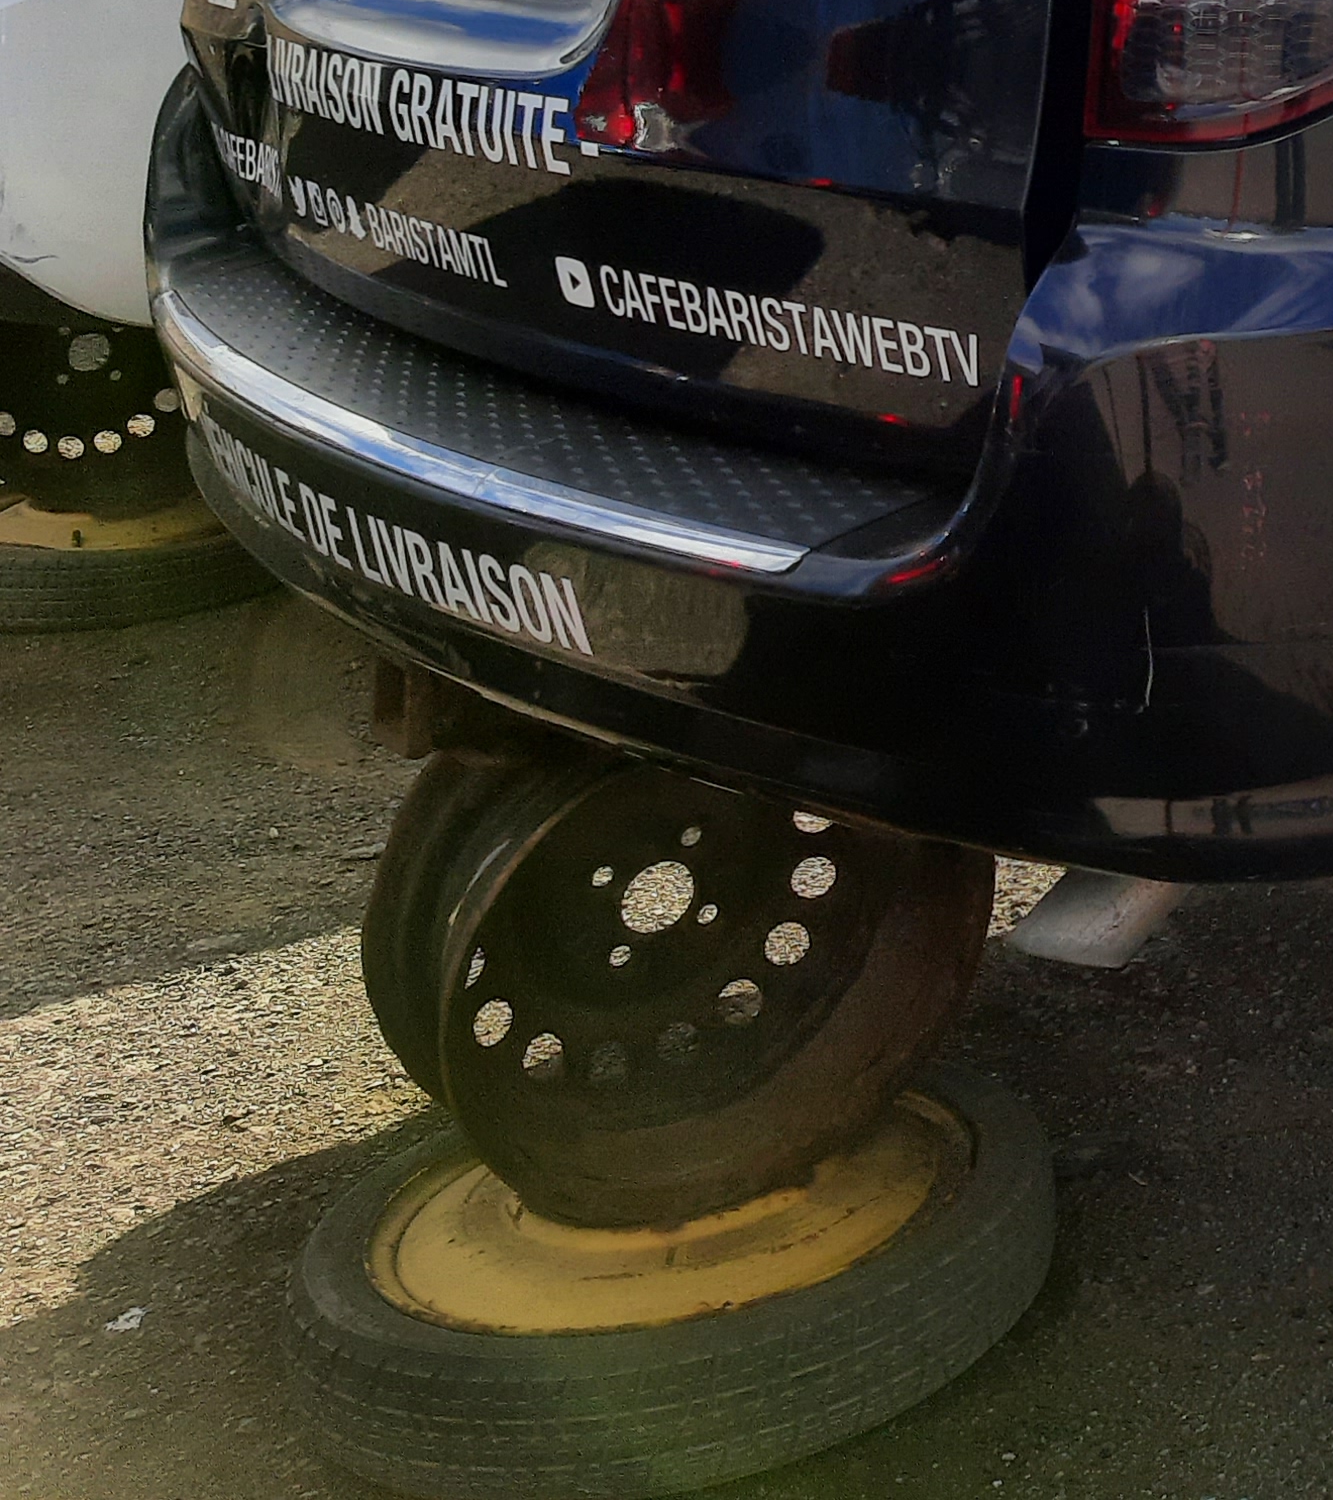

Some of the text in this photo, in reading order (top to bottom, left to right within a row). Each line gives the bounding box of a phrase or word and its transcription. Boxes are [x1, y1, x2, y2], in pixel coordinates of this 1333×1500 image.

[266, 34, 385, 135] LIVRAISON
[388, 68, 572, 176] GRATUITE
[365, 202, 509, 288] BARISTAMTL
[600, 263, 979, 388] CAFEBARISTAWEBTV
[299, 482, 354, 570] DE
[346, 506, 594, 657] LIVRAISON
